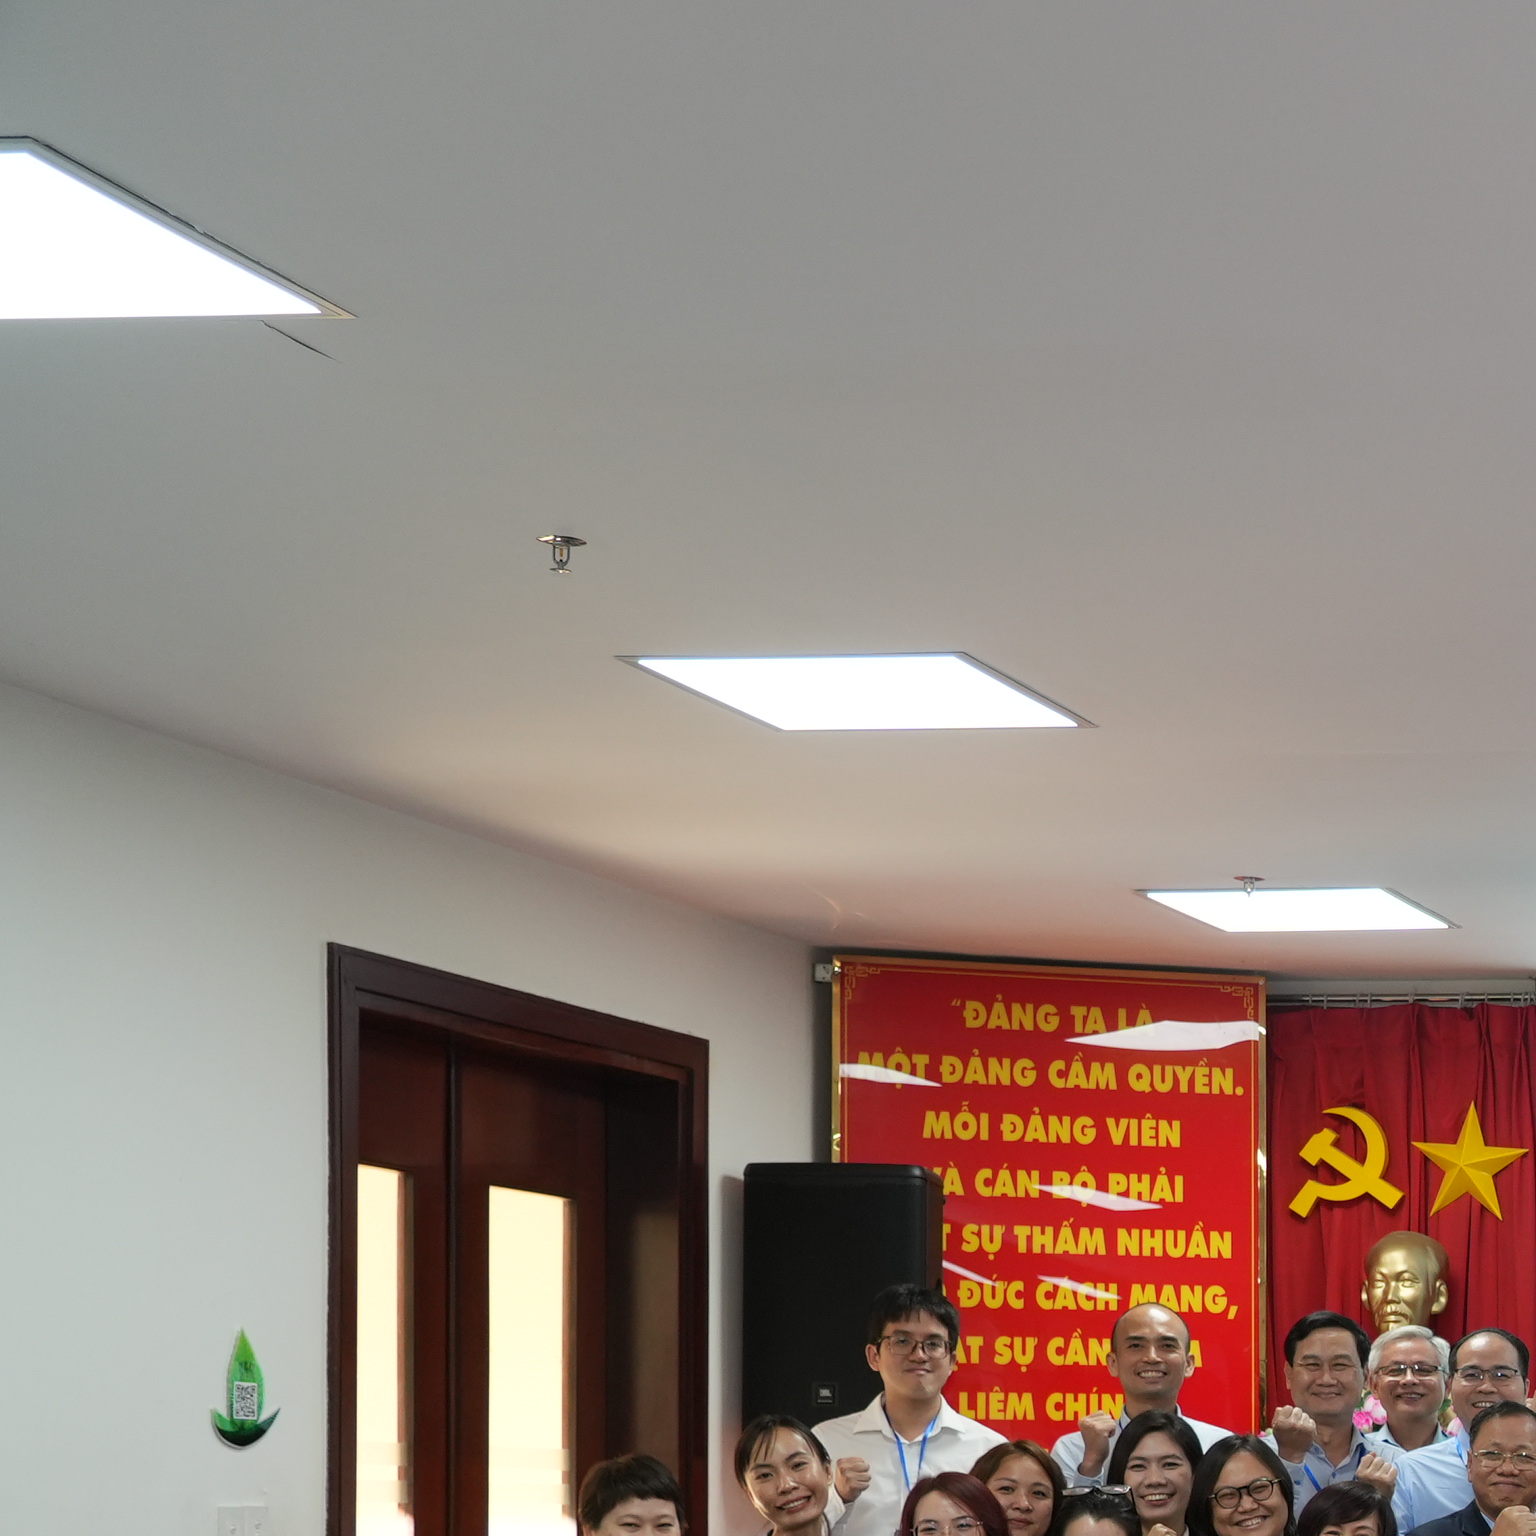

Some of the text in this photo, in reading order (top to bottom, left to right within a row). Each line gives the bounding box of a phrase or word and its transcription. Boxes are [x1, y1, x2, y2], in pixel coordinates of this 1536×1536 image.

[1071, 1006, 1106, 1034] TA
[939, 1049, 1037, 1088] ĐẢNG
[1048, 1052, 1117, 1091] CẦM
[1128, 1057, 1244, 1096] QUYỀN.
[922, 1101, 1181, 1147] MỖI ĐẢNG VIÊN
[975, 1163, 1039, 1198] CÁN
[1053, 1166, 1096, 1207] BỘ
[1108, 1168, 1184, 1203] PHẢI
[962, 1224, 1005, 1260] SỰ
[1014, 1218, 1104, 1256] THẤM
[1117, 1221, 1232, 1259] NHUẦN
[957, 1274, 1024, 1309] ĐỨC
[1036, 1277, 1118, 1311] CÁCH
[994, 1336, 1038, 1372] SỰ
[1047, 1329, 1111, 1366] CẦN
[959, 1388, 1034, 1421] LIÊM
